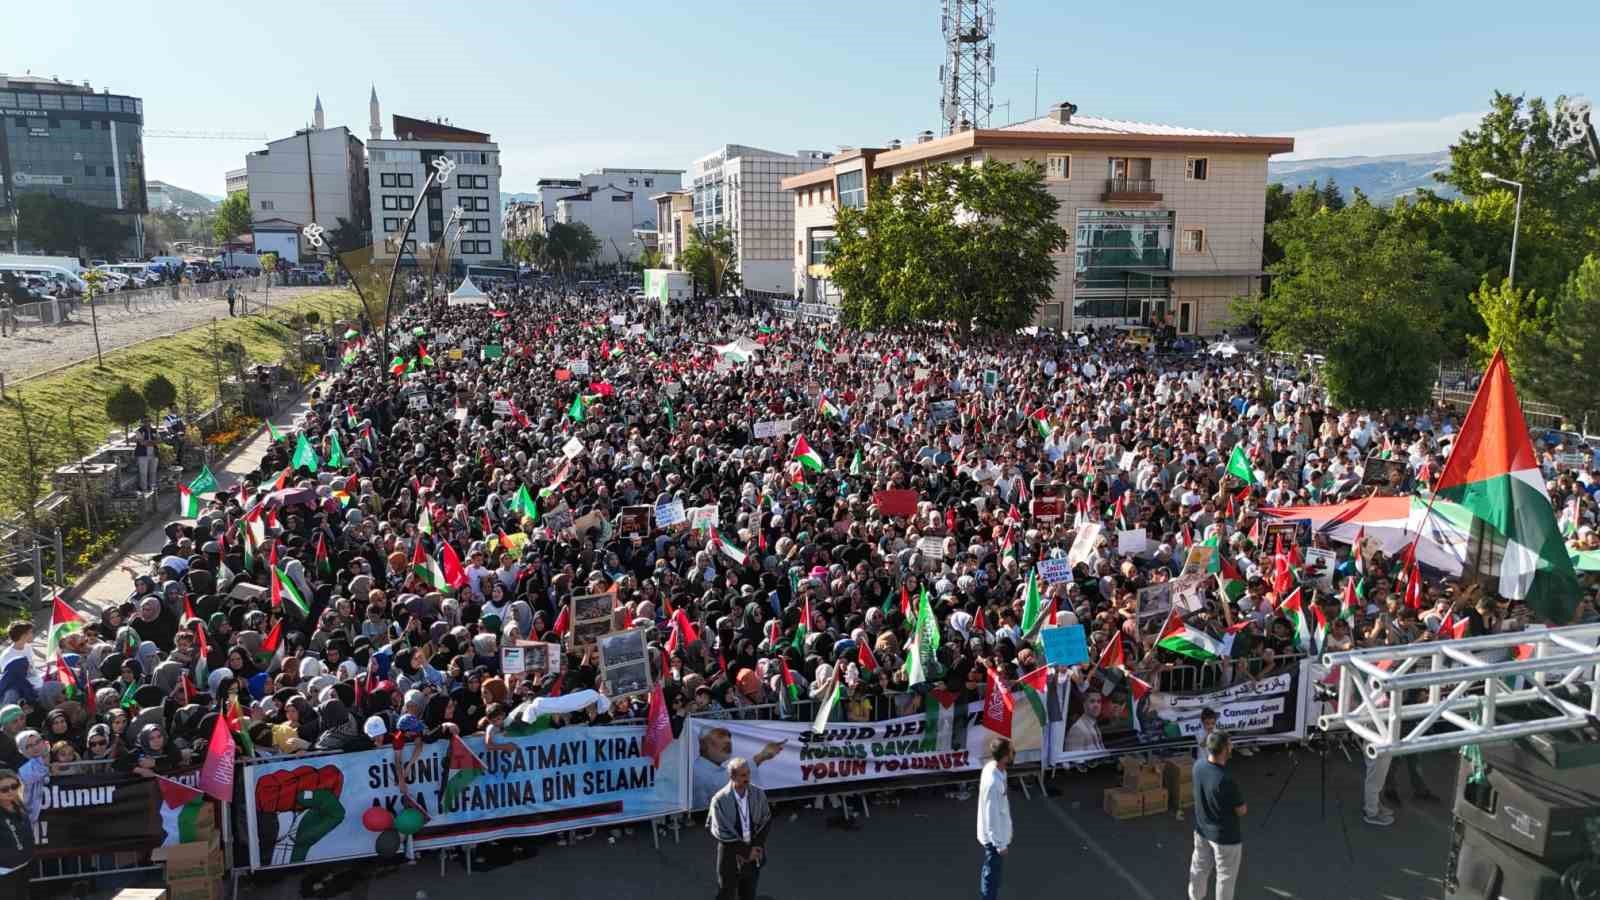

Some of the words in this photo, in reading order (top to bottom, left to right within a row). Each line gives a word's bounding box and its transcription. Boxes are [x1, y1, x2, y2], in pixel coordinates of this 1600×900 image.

[800, 759, 867, 781] YOLUN
[874, 750, 970, 772] YOLUMUZ!
[542, 771, 576, 802] BİN
[583, 764, 655, 795] SELAM!
